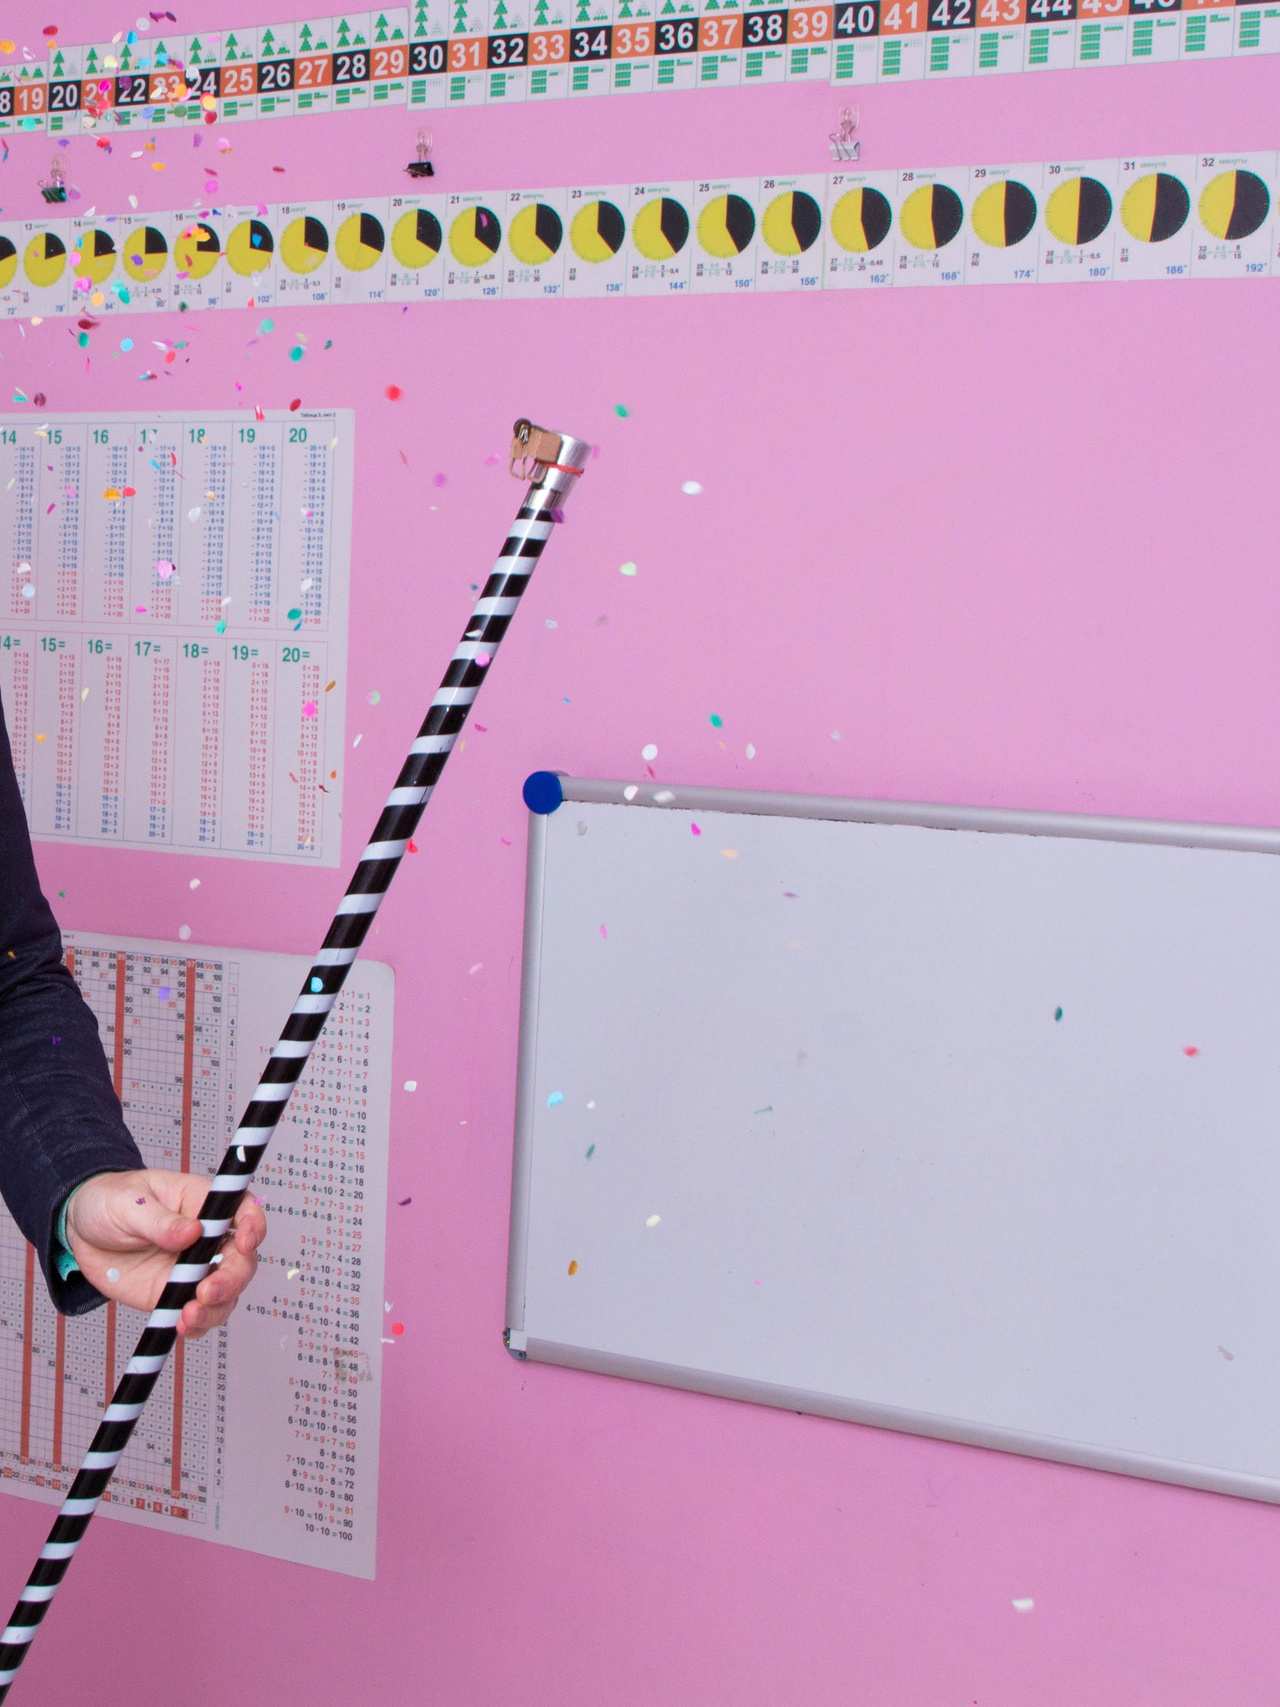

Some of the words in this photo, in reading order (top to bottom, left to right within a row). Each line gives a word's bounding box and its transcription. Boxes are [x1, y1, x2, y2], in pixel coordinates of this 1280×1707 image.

[19, 88, 43, 111] 19
[52, 84, 77, 108] 20
[189, 72, 217, 98] 24
[224, 68, 253, 93] 25
[261, 63, 290, 89] 26
[298, 59, 328, 85] 27
[336, 54, 365, 80] 28
[374, 50, 404, 76] 29
[412, 44, 443, 71] 30
[451, 41, 481, 68] 31
[491, 37, 523, 65] 32
[532, 34, 565, 61] 33
[574, 30, 607, 57] 34
[616, 26, 650, 53] 35
[658, 22, 693, 50] 36
[702, 19, 738, 46] 37
[747, 15, 783, 43] 38
[792, 10, 828, 39] 39
[838, 6, 875, 33] 40
[883, 2, 919, 30] 41
[931, 0, 970, 26] 42
[980, 0, 1020, 22] 43
[1124, 161, 1136, 170] 31
[1202, 158, 1214, 167] 32
[974, 169, 986, 178] 29
[1049, 165, 1061, 174] 30
[832, 176, 844, 184] 27
[902, 172, 914, 181] 28
[699, 184, 710, 192] 25
[764, 180, 774, 188] 26
[572, 190, 582, 198] 23
[634, 187, 644, 195] 24
[450, 196, 460, 204] 21
[510, 193, 520, 201] 22
[282, 206, 290, 214] 18
[337, 203, 345, 211] 19
[1, 430, 16, 444] 14
[47, 430, 62, 444] 15
[92, 430, 108, 444] 16
[189, 428, 206, 444] 18
[238, 428, 256, 443] 19
[289, 428, 307, 442] 20
